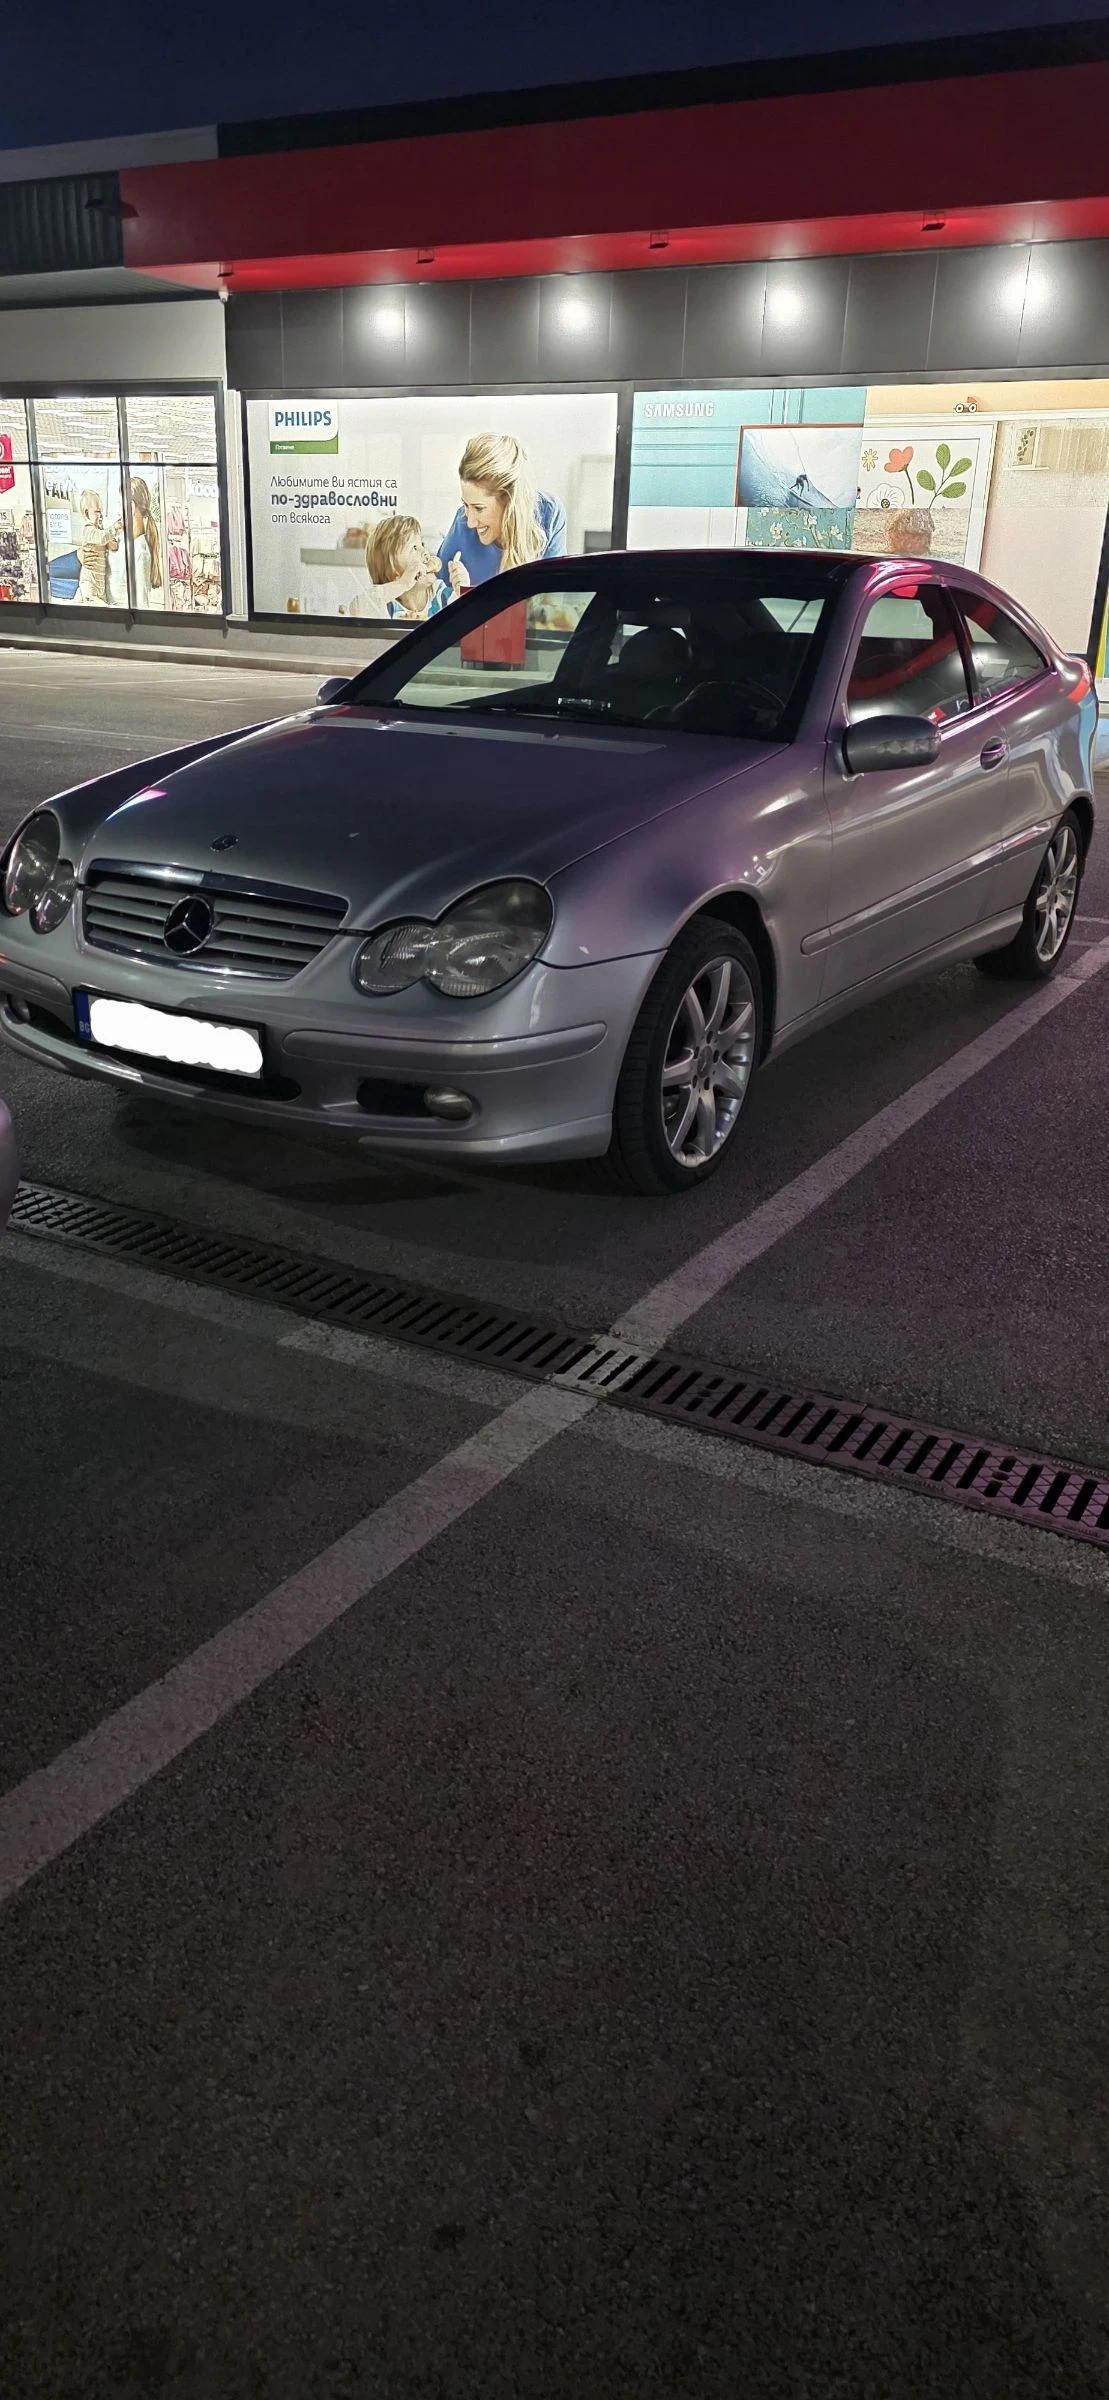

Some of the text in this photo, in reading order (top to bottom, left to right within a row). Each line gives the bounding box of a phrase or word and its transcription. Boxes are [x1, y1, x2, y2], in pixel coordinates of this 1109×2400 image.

[644, 402, 714, 418] SAMSUNG
[275, 410, 332, 427] PHILIPS
[270, 475, 398, 489] Любимите ви ястия са
[271, 491, 398, 509] по-здравословни
[271, 511, 331, 524] от всякога
[79, 1020, 90, 1033] BG
